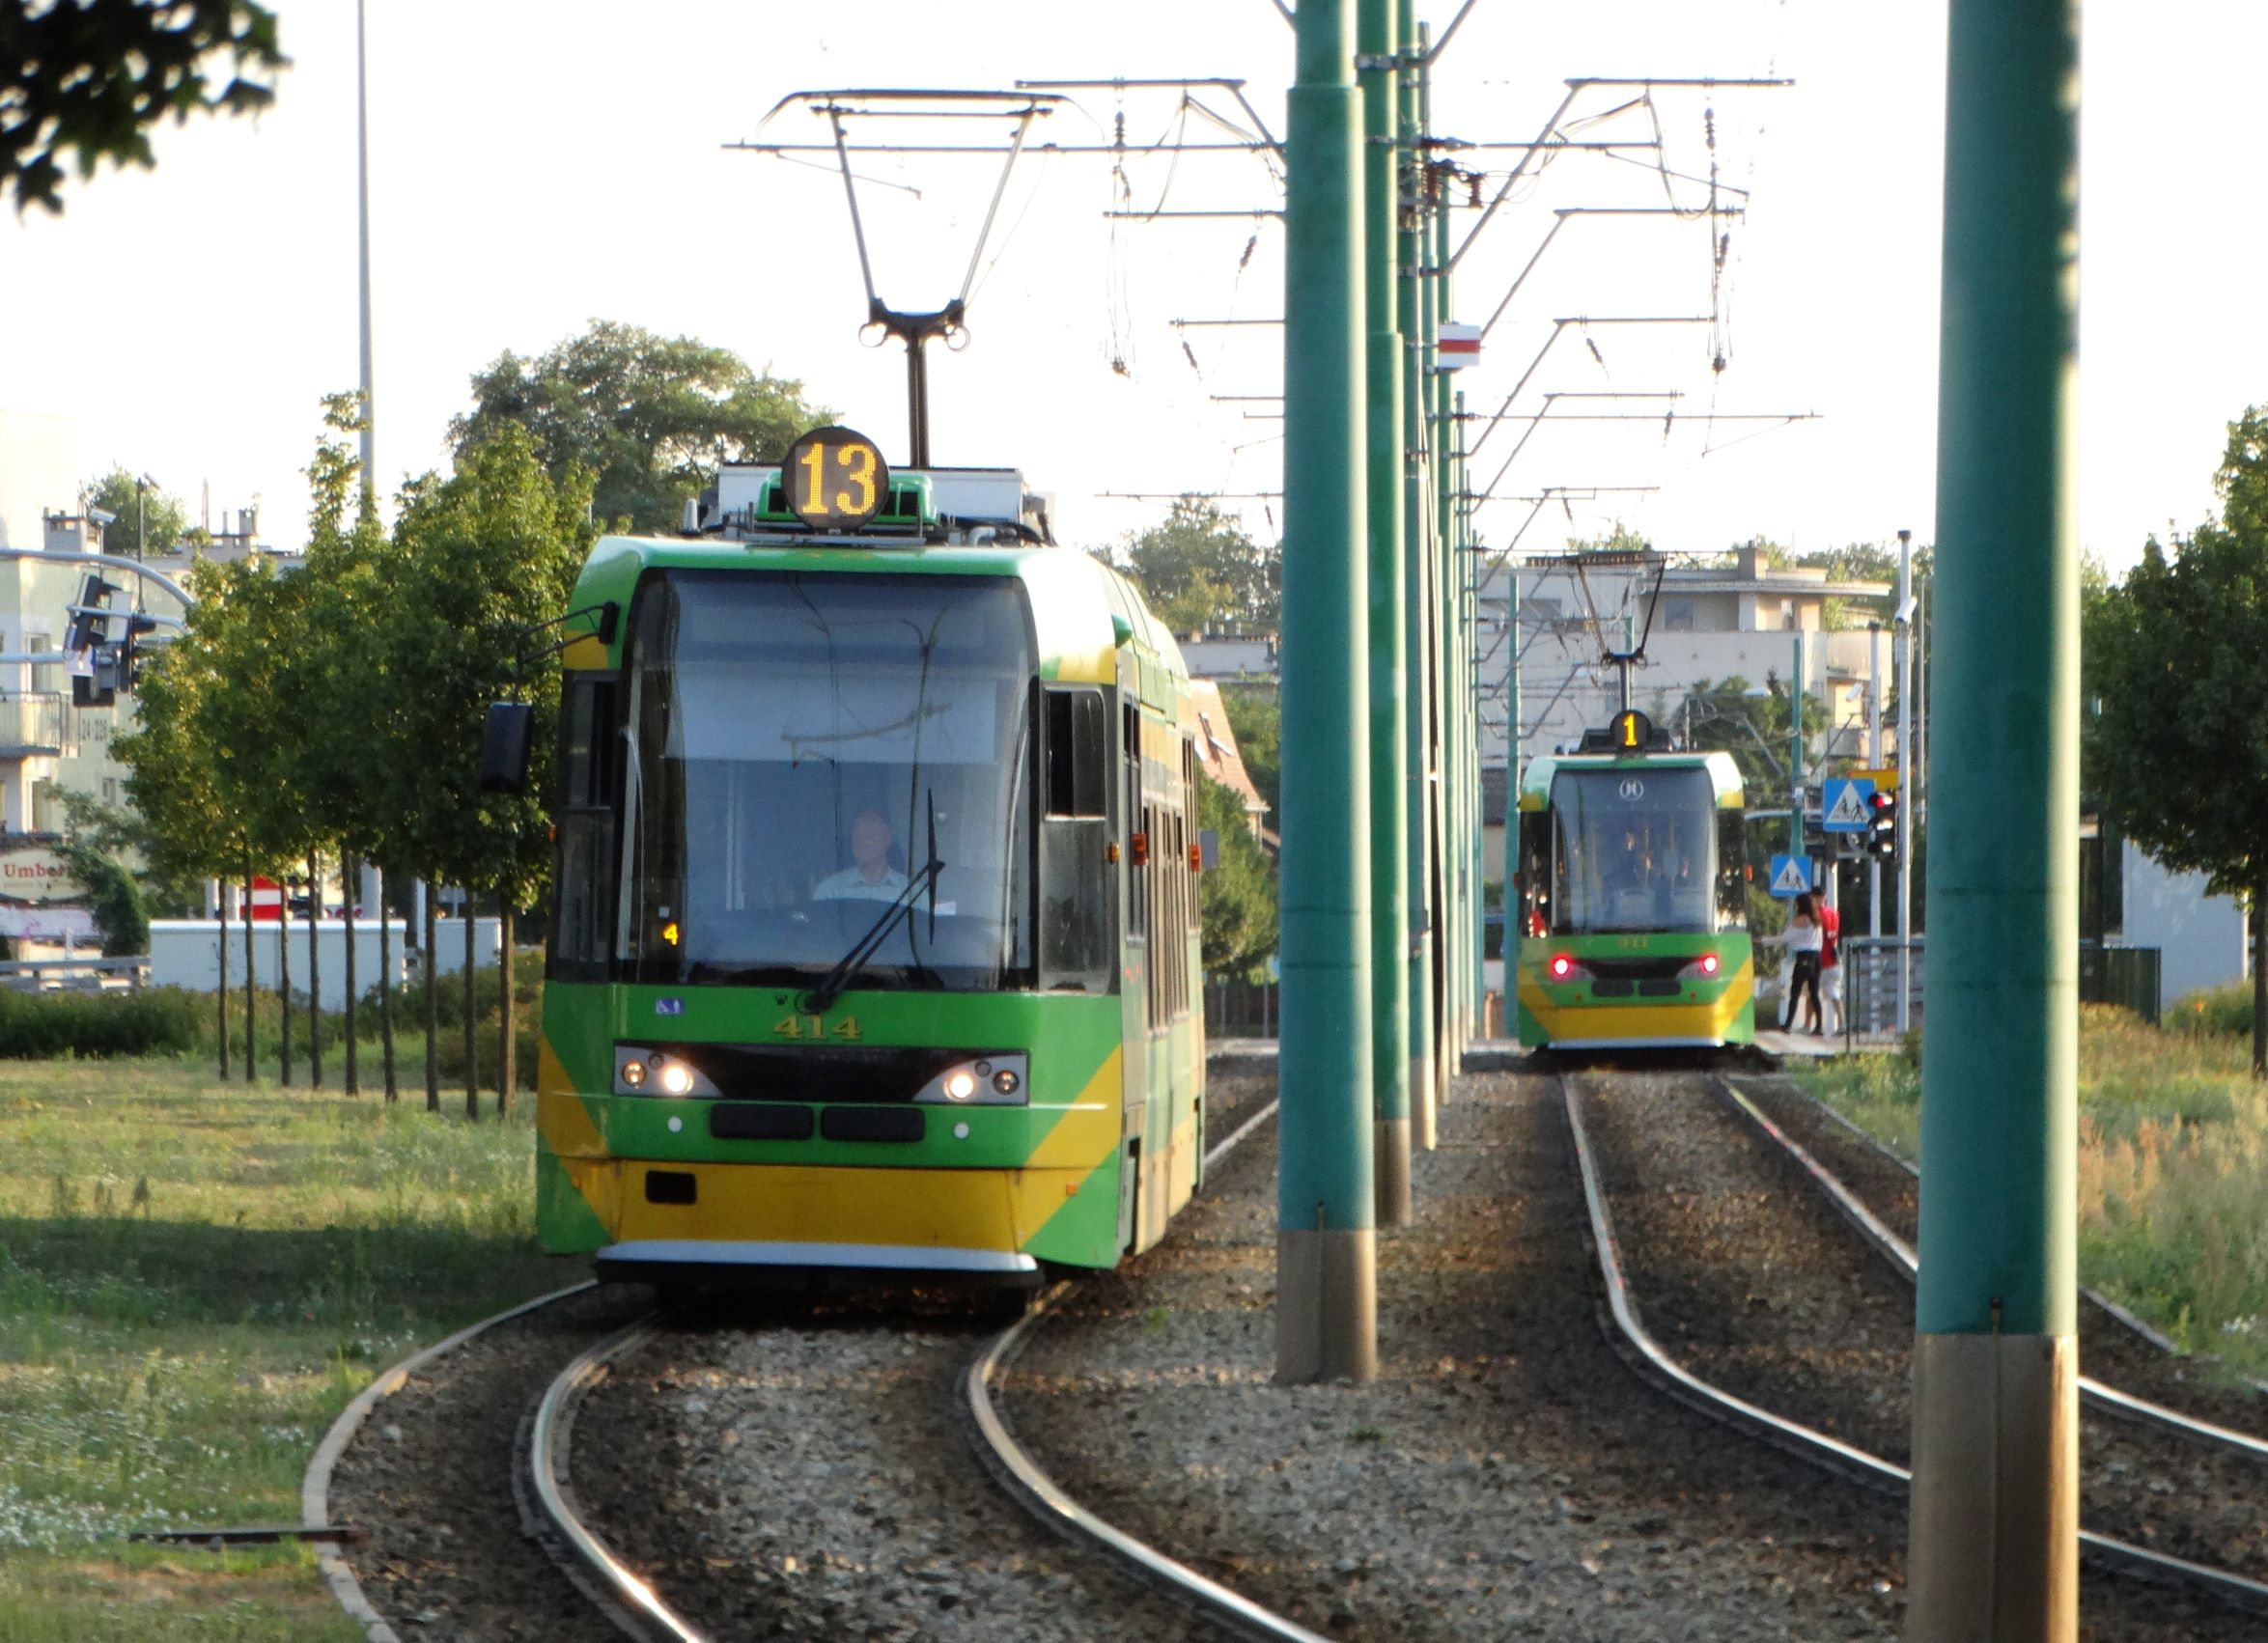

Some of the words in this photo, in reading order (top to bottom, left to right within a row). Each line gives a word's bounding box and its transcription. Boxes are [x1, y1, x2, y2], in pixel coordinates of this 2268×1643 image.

[801, 441, 876, 515] 13
[1624, 713, 1638, 746] 1
[4, 862, 72, 878] Umber
[663, 922, 679, 945] 4
[773, 1013, 862, 1041] 414
